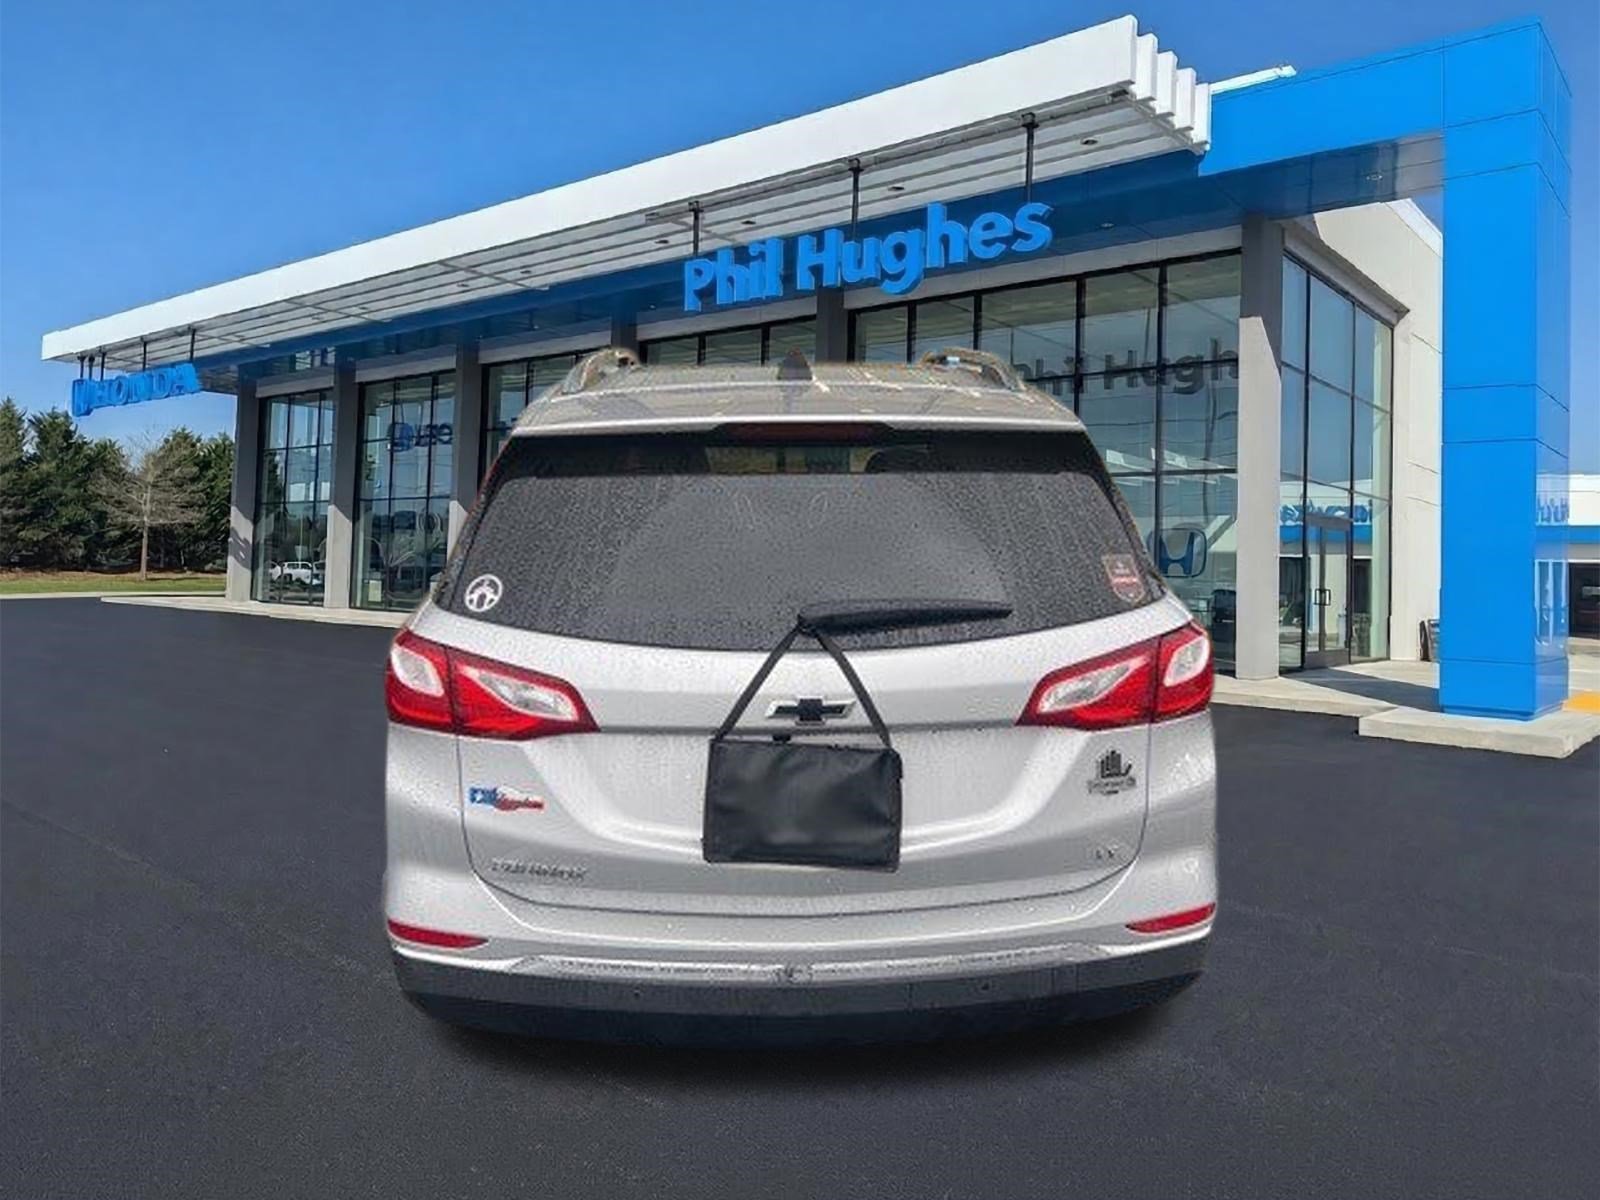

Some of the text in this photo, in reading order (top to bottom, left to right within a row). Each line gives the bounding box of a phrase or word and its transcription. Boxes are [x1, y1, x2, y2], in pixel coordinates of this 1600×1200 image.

[684, 202, 1053, 312] Phil Hughes
[96, 363, 200, 408] HONDA
